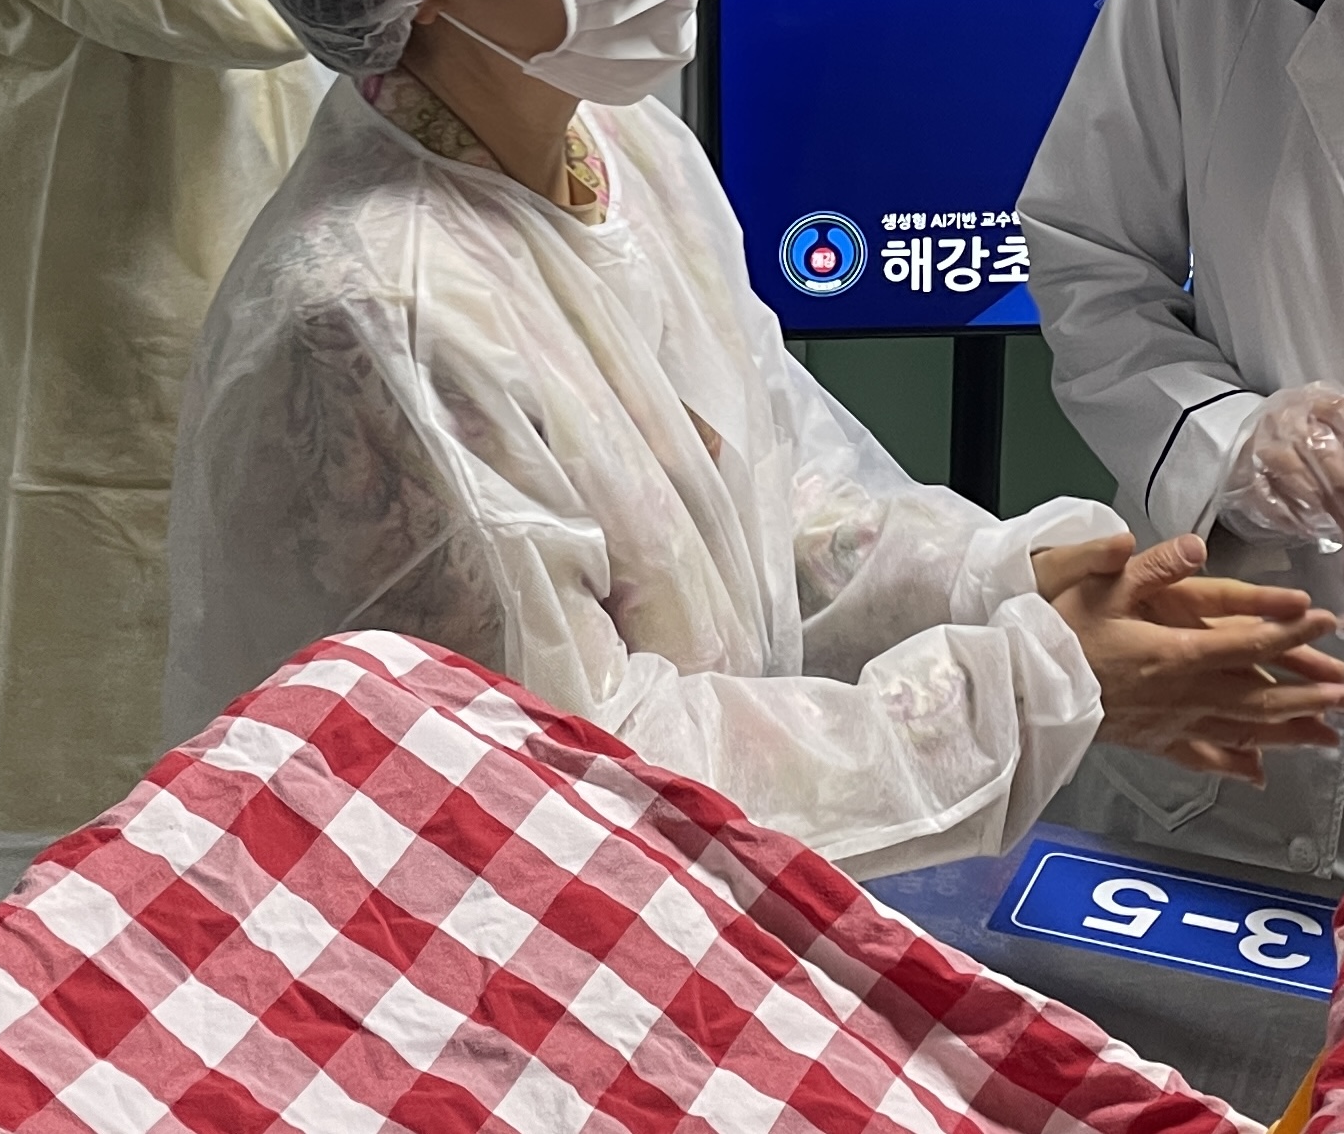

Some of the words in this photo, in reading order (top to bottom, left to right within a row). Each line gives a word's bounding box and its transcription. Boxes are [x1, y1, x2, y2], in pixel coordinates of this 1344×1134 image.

[881, 212, 927, 231] 생성형
[930, 211, 978, 230] AI기반
[881, 235, 1031, 293] 해강초
[1082, 878, 1323, 970] 3-5
